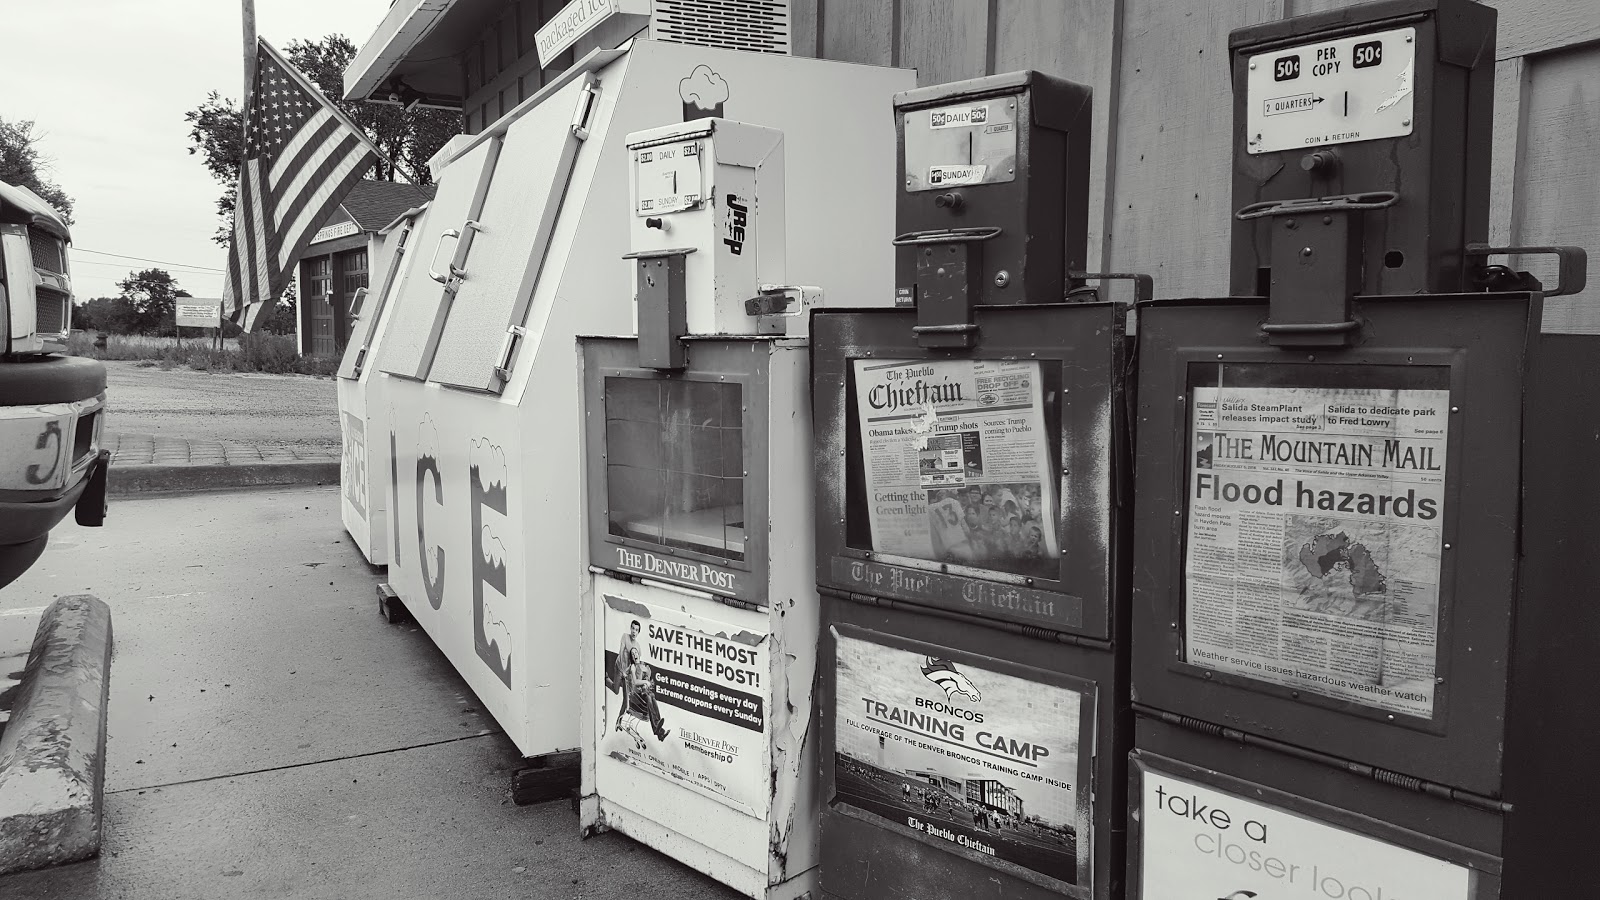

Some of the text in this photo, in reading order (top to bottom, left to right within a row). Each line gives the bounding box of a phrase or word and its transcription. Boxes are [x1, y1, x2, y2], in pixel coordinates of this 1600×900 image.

[540, 0, 586, 60] packaged
[1317, 46, 1337, 62] PER
[1355, 46, 1381, 65] 50¢
[1276, 60, 1300, 78] 50¢
[1312, 61, 1341, 77] COPY
[1266, 97, 1312, 113] 2 QUARTERS
[932, 111, 986, 124] 50¢ DAILY 50¢
[1332, 132, 1360, 141] RETURN
[659, 150, 676, 160] DAILY
[943, 170, 971, 180] SUNDAY
[658, 197, 678, 206] SUNDAY
[333, 226, 344, 237] FIRE
[886, 366, 935, 381] The Pueblo
[976, 377, 992, 385] FREE
[993, 373, 1030, 383] RECYCLING
[977, 382, 1001, 391] DROP
[1002, 380, 1019, 389] OFF
[868, 375, 963, 414] Chieftain
[1221, 403, 1303, 413] Salida SteamPlant
[1327, 405, 1436, 417] Salida to dedicate park
[933, 423, 959, 435] Trump
[959, 421, 979, 431] shots
[983, 418, 1026, 428] Sources: Trump
[1221, 414, 1257, 422] releases
[1259, 414, 1290, 424] impact
[1291, 416, 1317, 426] study
[1327, 417, 1390, 428] to Fred Lowry
[868, 429, 893, 438] Obama
[894, 427, 913, 437] takes
[984, 426, 1005, 436] coming
[1012, 424, 1032, 433] Pueblo
[1214, 432, 1441, 471] THE MOUNTAIN MAIL
[874, 491, 925, 504] Getting the
[1196, 473, 1438, 521] Flood hazards
[876, 504, 926, 517] Green light
[1208, 505, 1222, 513] flood
[1199, 518, 1219, 526] Hayden
[387, 402, 513, 691] ICE
[616, 547, 736, 590] THE DENVER POST
[851, 561, 883, 585] The
[648, 624, 758, 666] SAVE THE MOST
[648, 643, 760, 688] WITH THE POST!
[1192, 647, 1229, 663] Weather
[1230, 656, 1262, 670] service
[1264, 662, 1294, 677] issues
[1295, 669, 1347, 688] hazardous
[1348, 681, 1392, 697] weather
[1394, 690, 1427, 703] watch
[655, 672, 758, 713] Get more savings every day
[655, 685, 762, 726] Extreme coupons every Sunday
[915, 697, 984, 724] BRONCOS
[861, 697, 1050, 761] TRAINING CAMP
[679, 727, 739, 754] THE DENVER POST
[684, 741, 726, 763] Membership
[846, 718, 1072, 792] FULL COVERAGE OF THE DENVER BRONCOS TRAINING CAMP INSIDE
[672, 764, 690, 777] MOBILE
[697, 773, 711, 783] APPS
[1155, 785, 1267, 844] take a
[907, 816, 995, 856] The Pueblo Chieftain
[1194, 832, 1300, 883] closer
